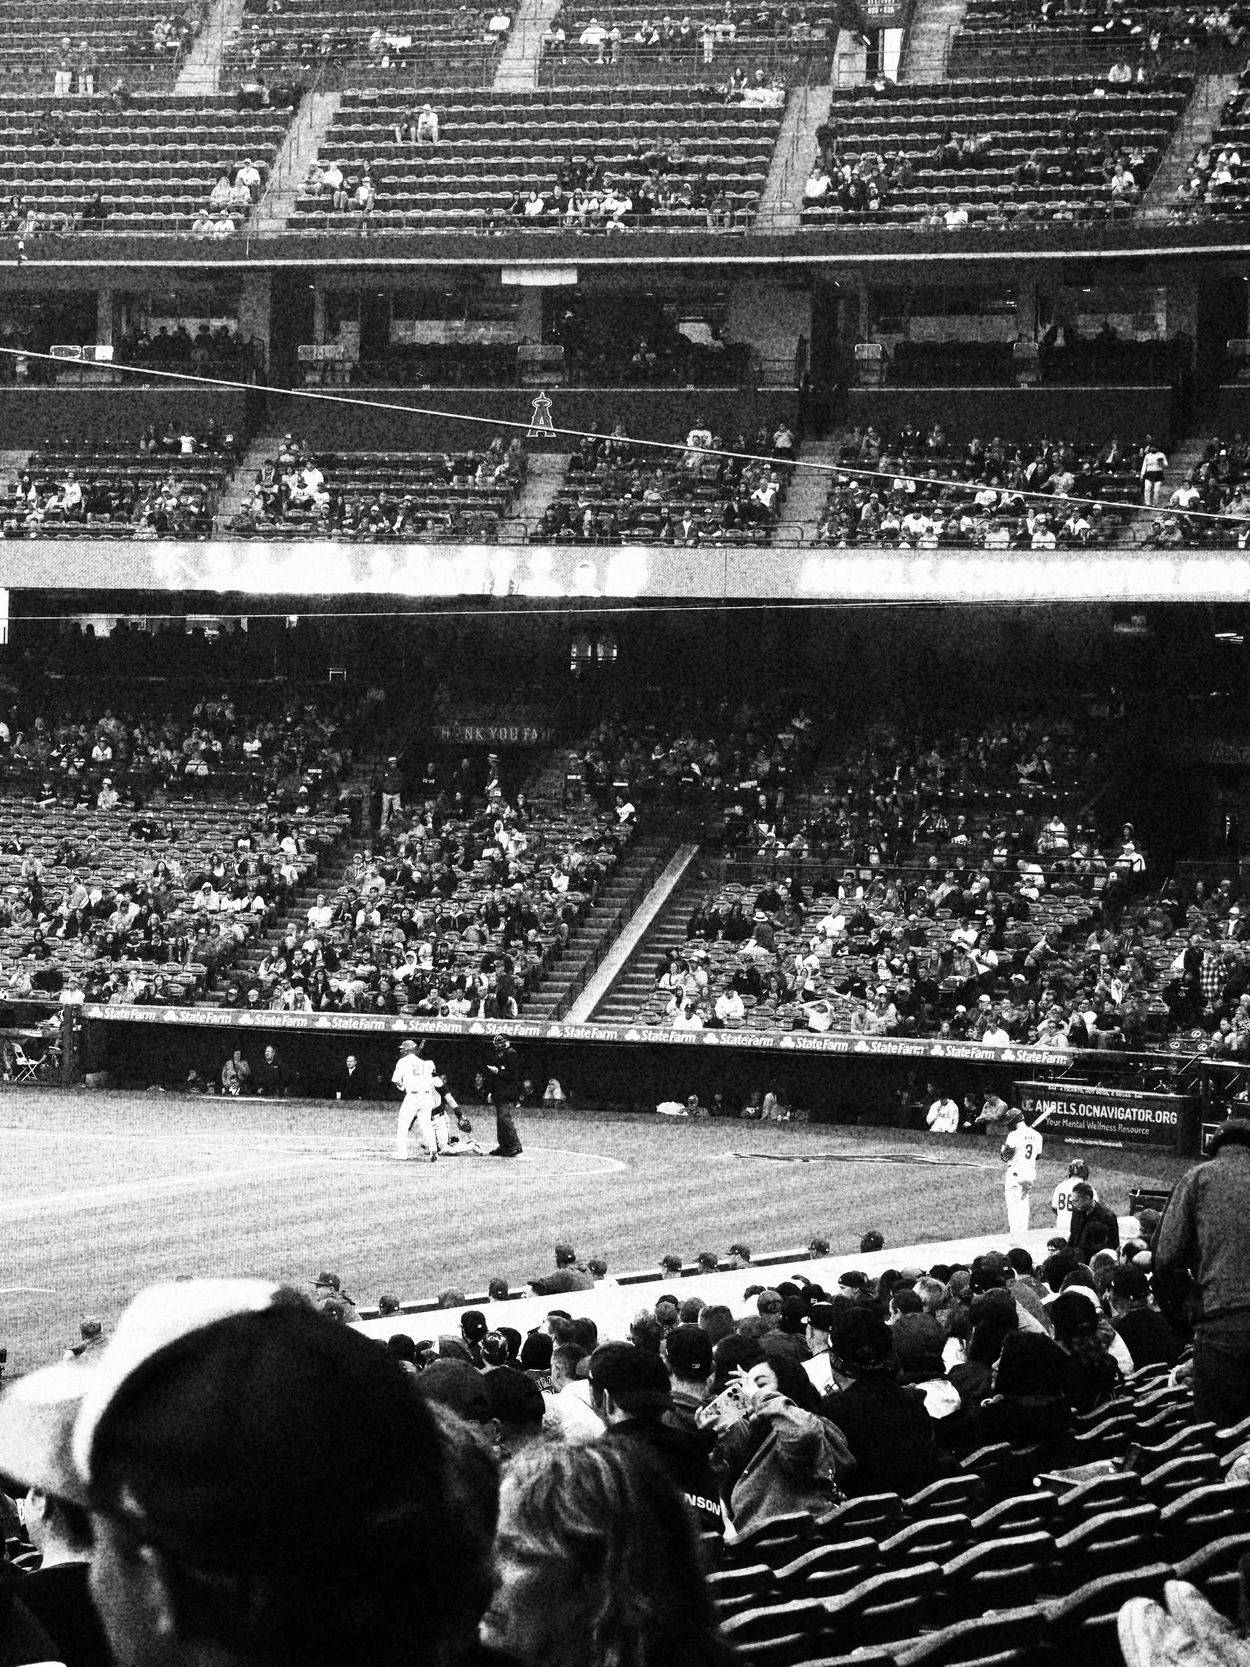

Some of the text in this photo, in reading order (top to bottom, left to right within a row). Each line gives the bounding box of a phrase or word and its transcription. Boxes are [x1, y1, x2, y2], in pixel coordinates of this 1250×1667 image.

[1062, 1119, 1086, 1129] Mental
[1087, 1121, 1117, 1132] Wellness
[1118, 1124, 1150, 1136] Resource
[1025, 1143, 1033, 1160] 3
[684, 1492, 721, 1516] NSON
